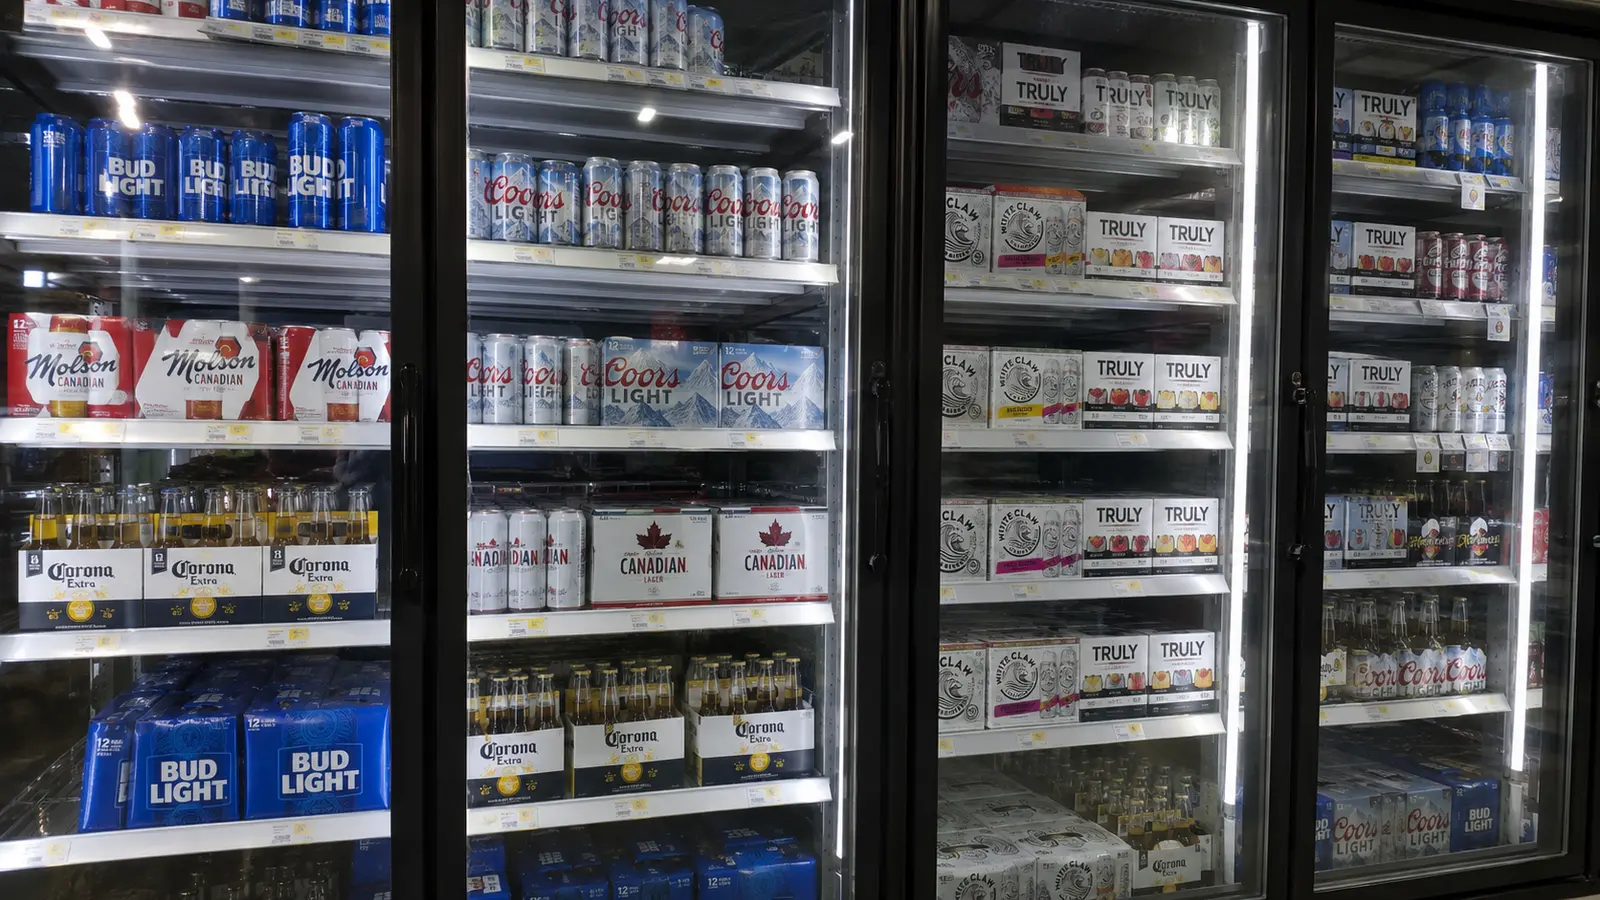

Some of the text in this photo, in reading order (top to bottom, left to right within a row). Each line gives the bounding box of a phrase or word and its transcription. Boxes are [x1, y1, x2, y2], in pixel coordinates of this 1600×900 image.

[1016, 81, 1068, 103] TRULY
[1096, 85, 1145, 107] TRULY
[1165, 89, 1212, 110] TRULY
[1361, 94, 1411, 117] TRULY
[108, 156, 156, 178] BUD
[190, 159, 226, 181] BUD
[290, 154, 335, 179] BUD
[98, 174, 165, 196] LIGHT
[946, 197, 980, 222] CLAW
[1000, 202, 1042, 235] WHITE CLAW
[710, 215, 743, 229] LIGH
[1100, 219, 1147, 238] TRULY
[1169, 224, 1215, 243] TRULY
[1365, 228, 1408, 246] TRULY
[607, 341, 620, 351] 12
[725, 346, 735, 355] 12
[25, 353, 118, 387] Molson
[161, 348, 256, 385] Molson
[307, 357, 389, 389] Molson
[605, 356, 680, 388] Coors
[944, 355, 977, 377] CLAW
[999, 356, 1039, 387] WHITE CLAW
[1097, 360, 1144, 377] TRULY
[1166, 362, 1211, 379] TRULY
[1361, 365, 1403, 382] TRULY
[57, 376, 105, 389] CANADIAN
[194, 373, 243, 386] CANADIAN
[721, 361, 790, 391] Coors
[336, 380, 378, 391] CANADIAN
[611, 388, 672, 404] LIGHT
[726, 391, 782, 406] LIGHT
[942, 510, 975, 531] CLAW
[1096, 507, 1143, 523] TRULY
[1164, 506, 1209, 522] TRULY
[998, 508, 1039, 541] WHITE CLAW
[171, 560, 236, 580] Corona
[289, 557, 351, 577] Corona
[620, 557, 687, 575] CANADIAN
[744, 554, 806, 572] CANADIAN
[47, 562, 115, 583] Corona
[190, 576, 218, 586] Extra
[307, 573, 333, 582] Extra
[643, 576, 664, 584] LAGER
[765, 571, 785, 579] LAGER
[67, 578, 96, 589] Extra
[1092, 644, 1139, 661] TRULY
[1160, 640, 1205, 658] TRULY
[940, 656, 973, 677] CLAW
[996, 652, 1036, 685] WHITE CLAW
[247, 718, 260, 729] 12
[735, 721, 785, 739] Corona
[96, 737, 110, 748] 12
[605, 730, 658, 749] Corona
[749, 735, 772, 744] Extra
[480, 742, 537, 761] Corona
[620, 744, 644, 754] Extra
[160, 759, 218, 782] BUD
[292, 750, 350, 773] BUD
[496, 757, 522, 766] Extra
[281, 769, 359, 794] LIGHT
[150, 779, 227, 804] LIGHT
[1406, 808, 1449, 834] Coors
[1469, 807, 1490, 821] BUD
[1333, 816, 1378, 842] Coors
[1464, 818, 1493, 833] LIGHT
[1337, 839, 1375, 855] LIGHT
[1410, 831, 1446, 846] LIGHT
[1069, 860, 1092, 874] CLAW
[1152, 859, 1187, 873] Corona
[708, 877, 718, 887] 12
[970, 873, 995, 888] CLAW
